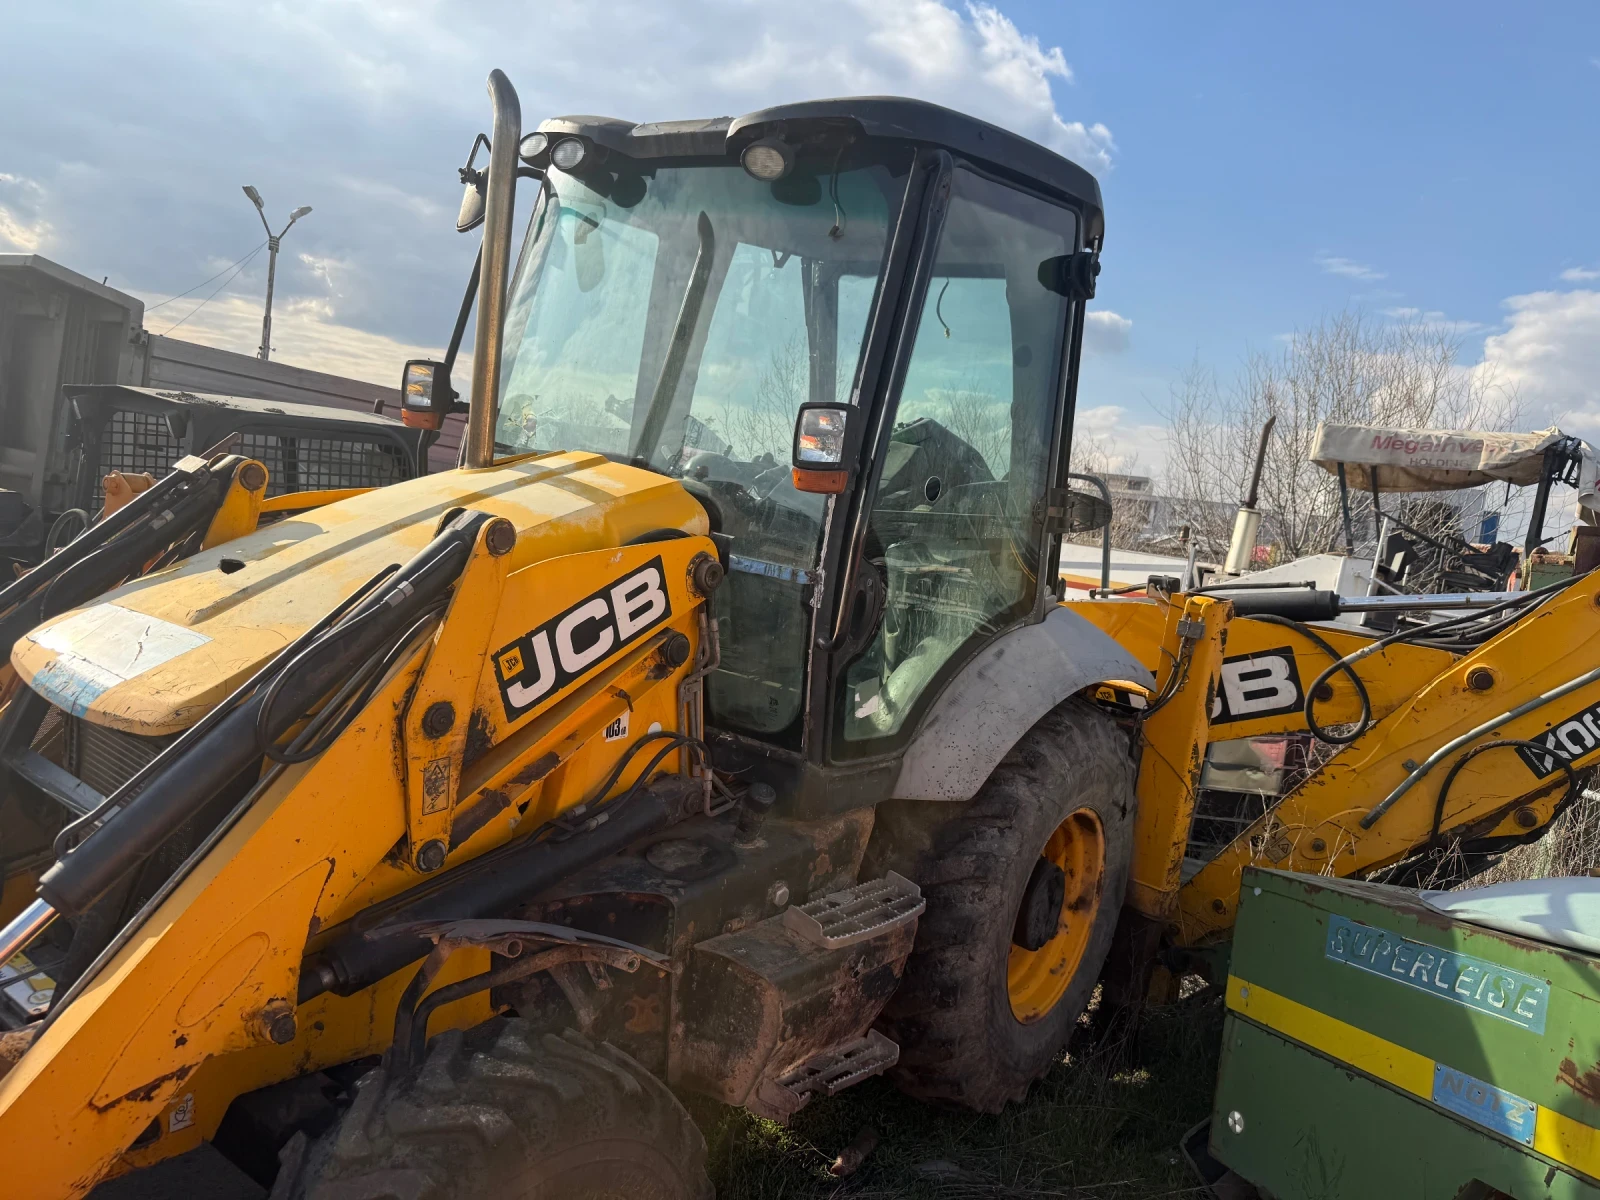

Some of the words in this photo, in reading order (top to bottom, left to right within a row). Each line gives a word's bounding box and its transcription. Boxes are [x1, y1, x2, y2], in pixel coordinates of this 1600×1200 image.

[504, 655, 519, 671] JCB
[506, 567, 666, 708] JCB
[1523, 746, 1547, 774] CONTRACTOR
[1331, 926, 1543, 1019] SUPERLEISE
[1441, 1071, 1528, 1125] NOTZ
